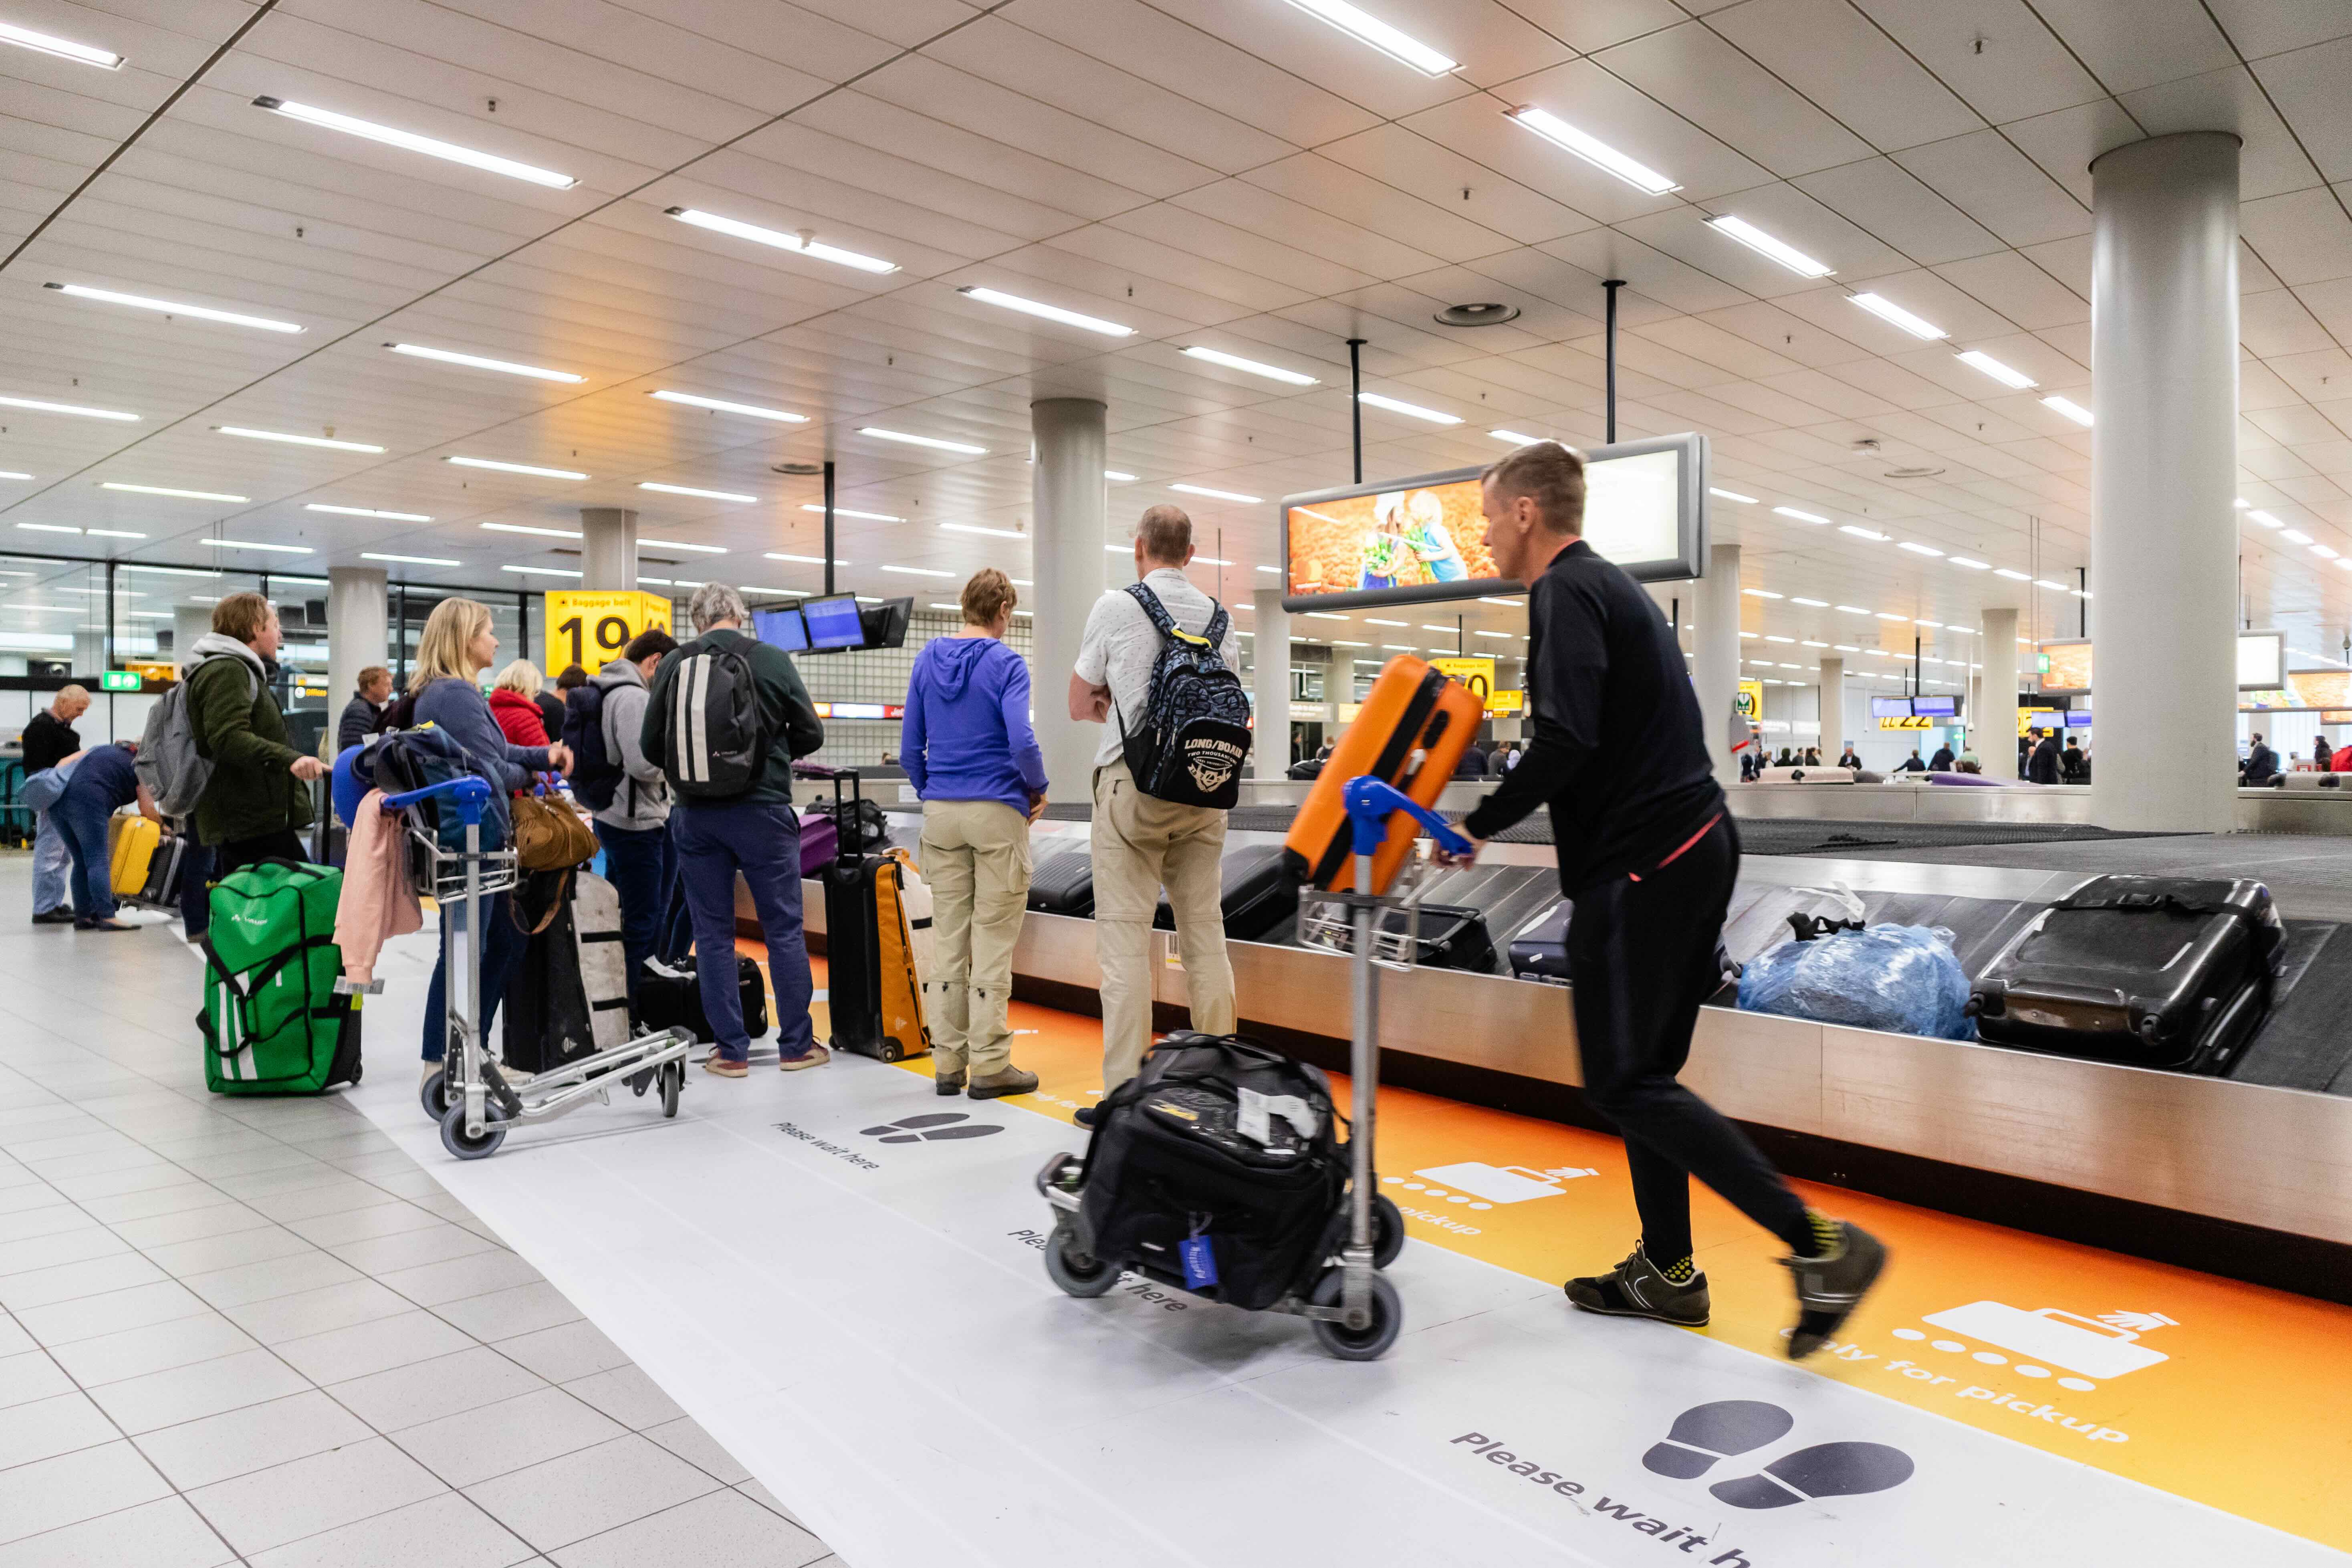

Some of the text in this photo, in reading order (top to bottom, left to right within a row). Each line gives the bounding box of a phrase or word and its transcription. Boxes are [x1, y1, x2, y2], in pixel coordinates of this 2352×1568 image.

[573, 598, 631, 607] Baggage belt
[558, 617, 630, 667] 19
[770, 1122, 879, 1169] Please wait here
[1007, 1229, 1047, 1250] Plea
[1124, 1283, 1188, 1311] here
[1884, 1360, 1956, 1385] for
[1955, 1386, 2129, 1443] pickup
[1449, 1432, 1585, 1496] Please
[1593, 1497, 1709, 1553] wait
